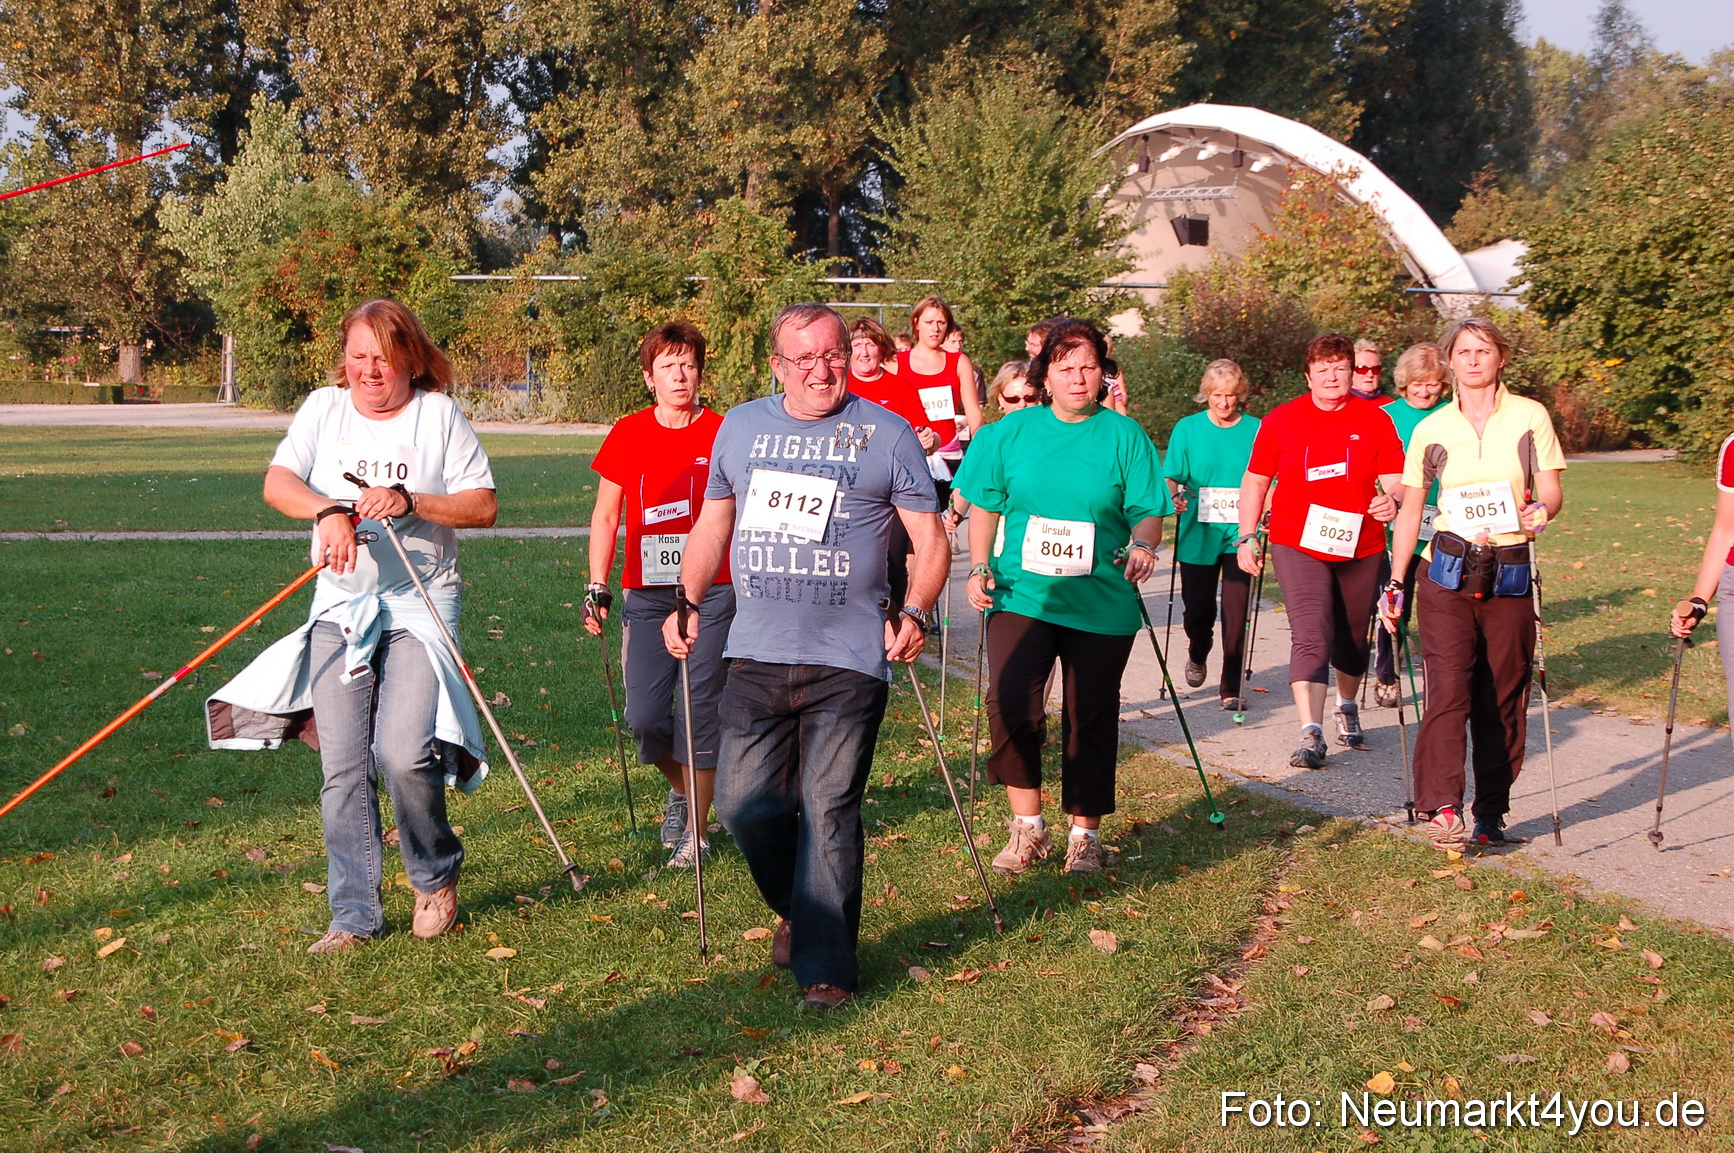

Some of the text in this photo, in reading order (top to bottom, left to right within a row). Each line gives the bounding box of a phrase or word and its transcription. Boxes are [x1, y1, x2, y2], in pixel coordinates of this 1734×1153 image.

[924, 398, 949, 410] 8107
[356, 459, 408, 480] 8110
[1460, 487, 1491, 500] Monika
[768, 490, 823, 516] 8112
[1464, 500, 1507, 520] 8051
[657, 506, 678, 518] DEHN
[1041, 523, 1071, 537] Ursula
[1319, 525, 1353, 542] 8023
[658, 534, 680, 544] Rosa
[1041, 540, 1084, 560] 8041
[737, 545, 851, 578] COLLEG
